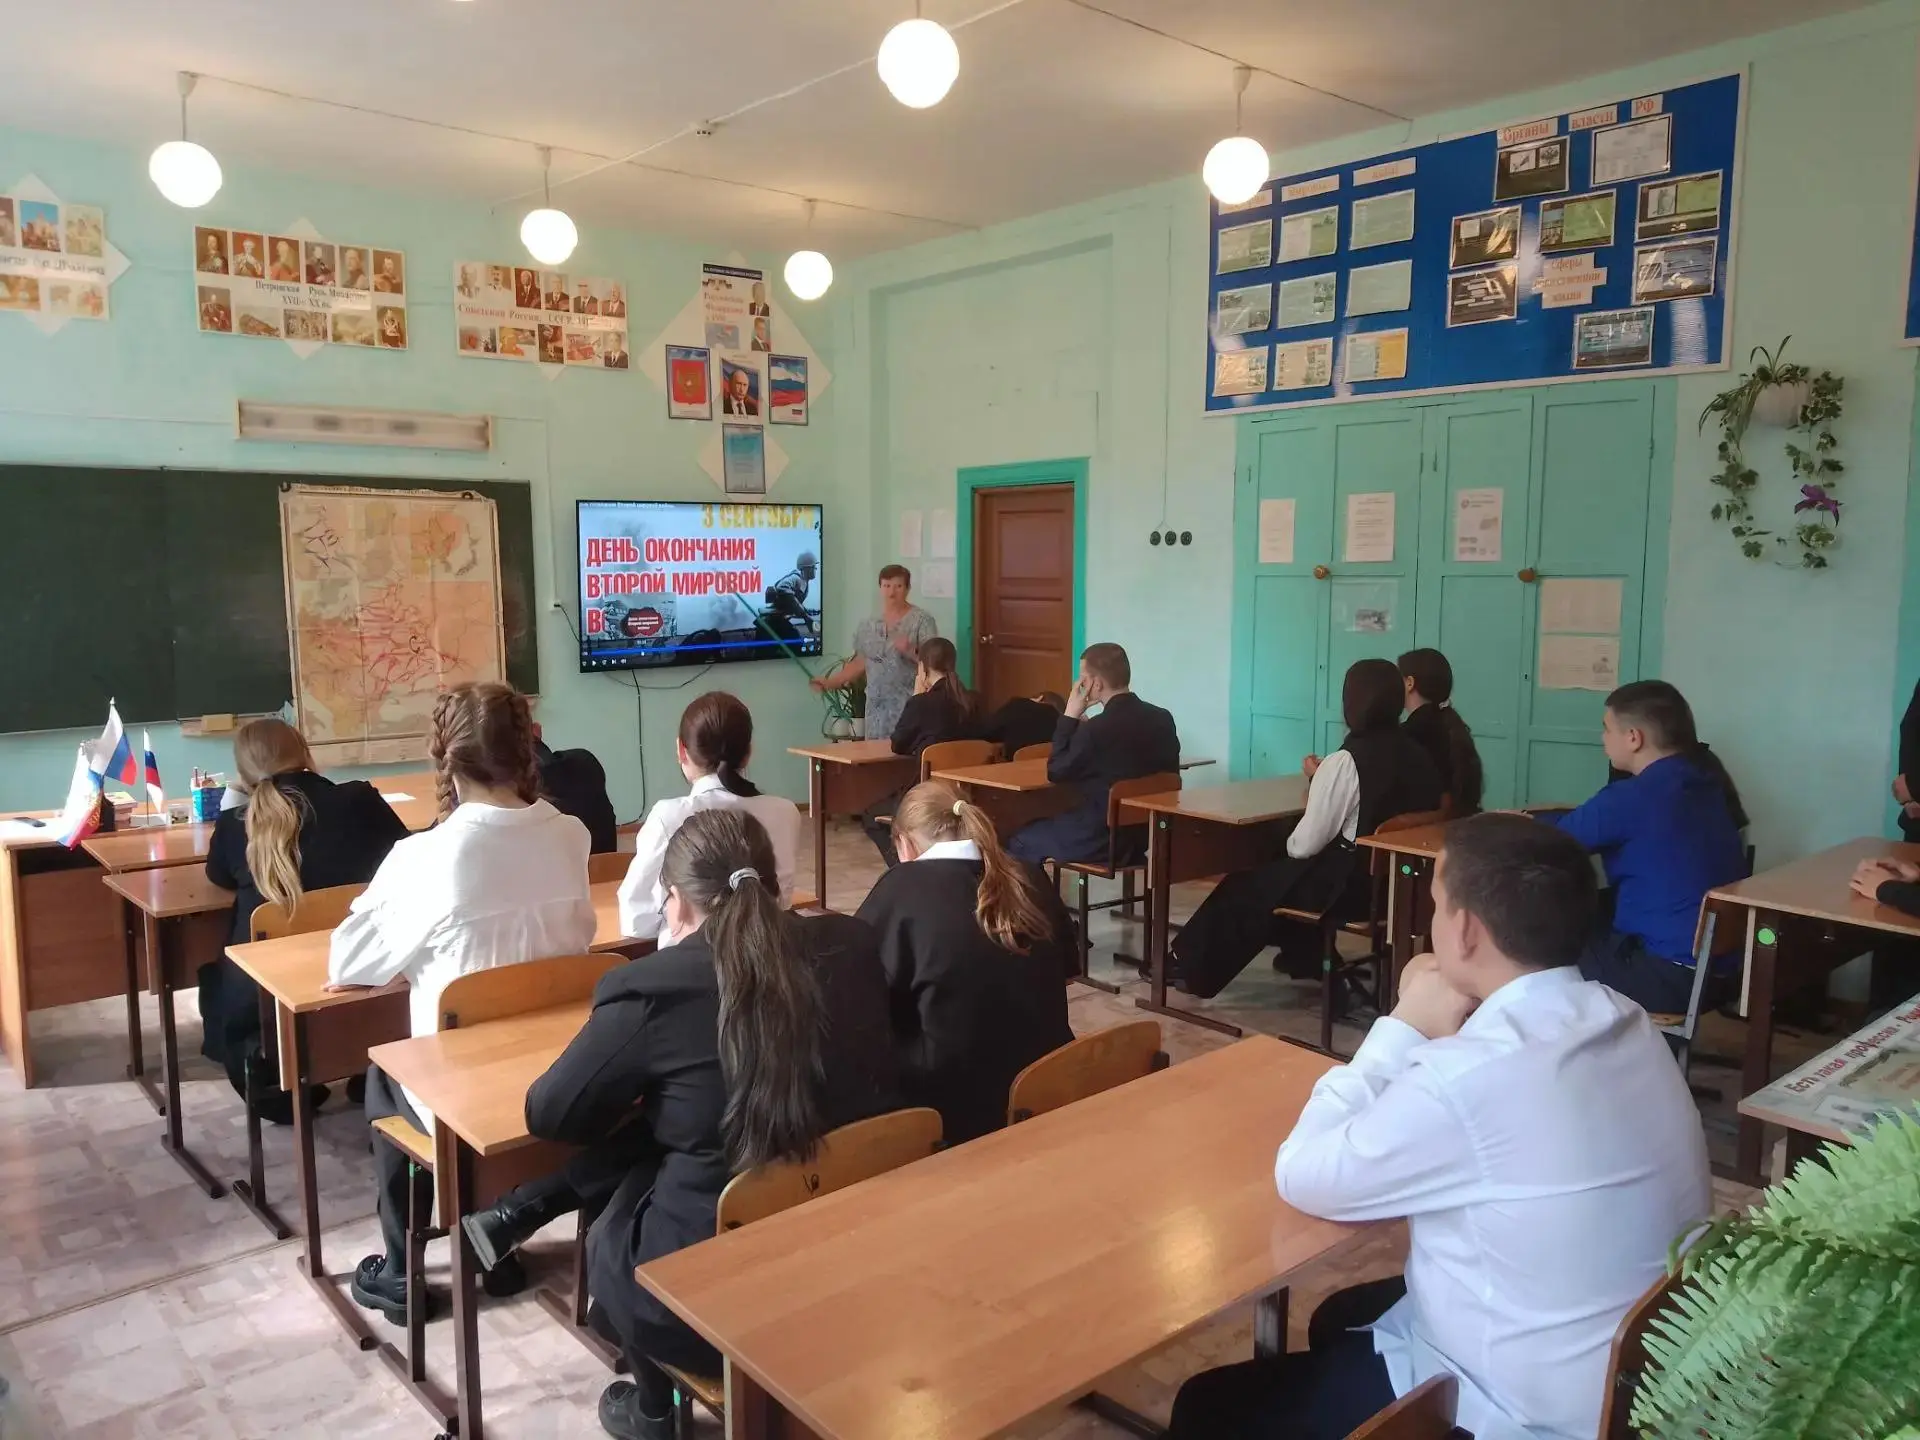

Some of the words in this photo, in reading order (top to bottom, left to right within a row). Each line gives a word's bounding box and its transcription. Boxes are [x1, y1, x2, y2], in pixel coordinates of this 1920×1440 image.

[1502, 123, 1549, 142] Органы
[1571, 111, 1614, 129] власти
[1635, 98, 1655, 114] РФ
[457, 303, 505, 318] Советская
[702, 504, 713, 528] 3
[586, 538, 639, 567] ДЕНЬ
[645, 538, 756, 563] ОКОНЧАНИЯ
[586, 567, 666, 599] ВТОРОЙ
[672, 565, 762, 596] МИРОВОЙ
[1783, 1075, 1820, 1093] Есть
[1814, 1057, 1849, 1081] такая
[1843, 1026, 1900, 1059] профессия
